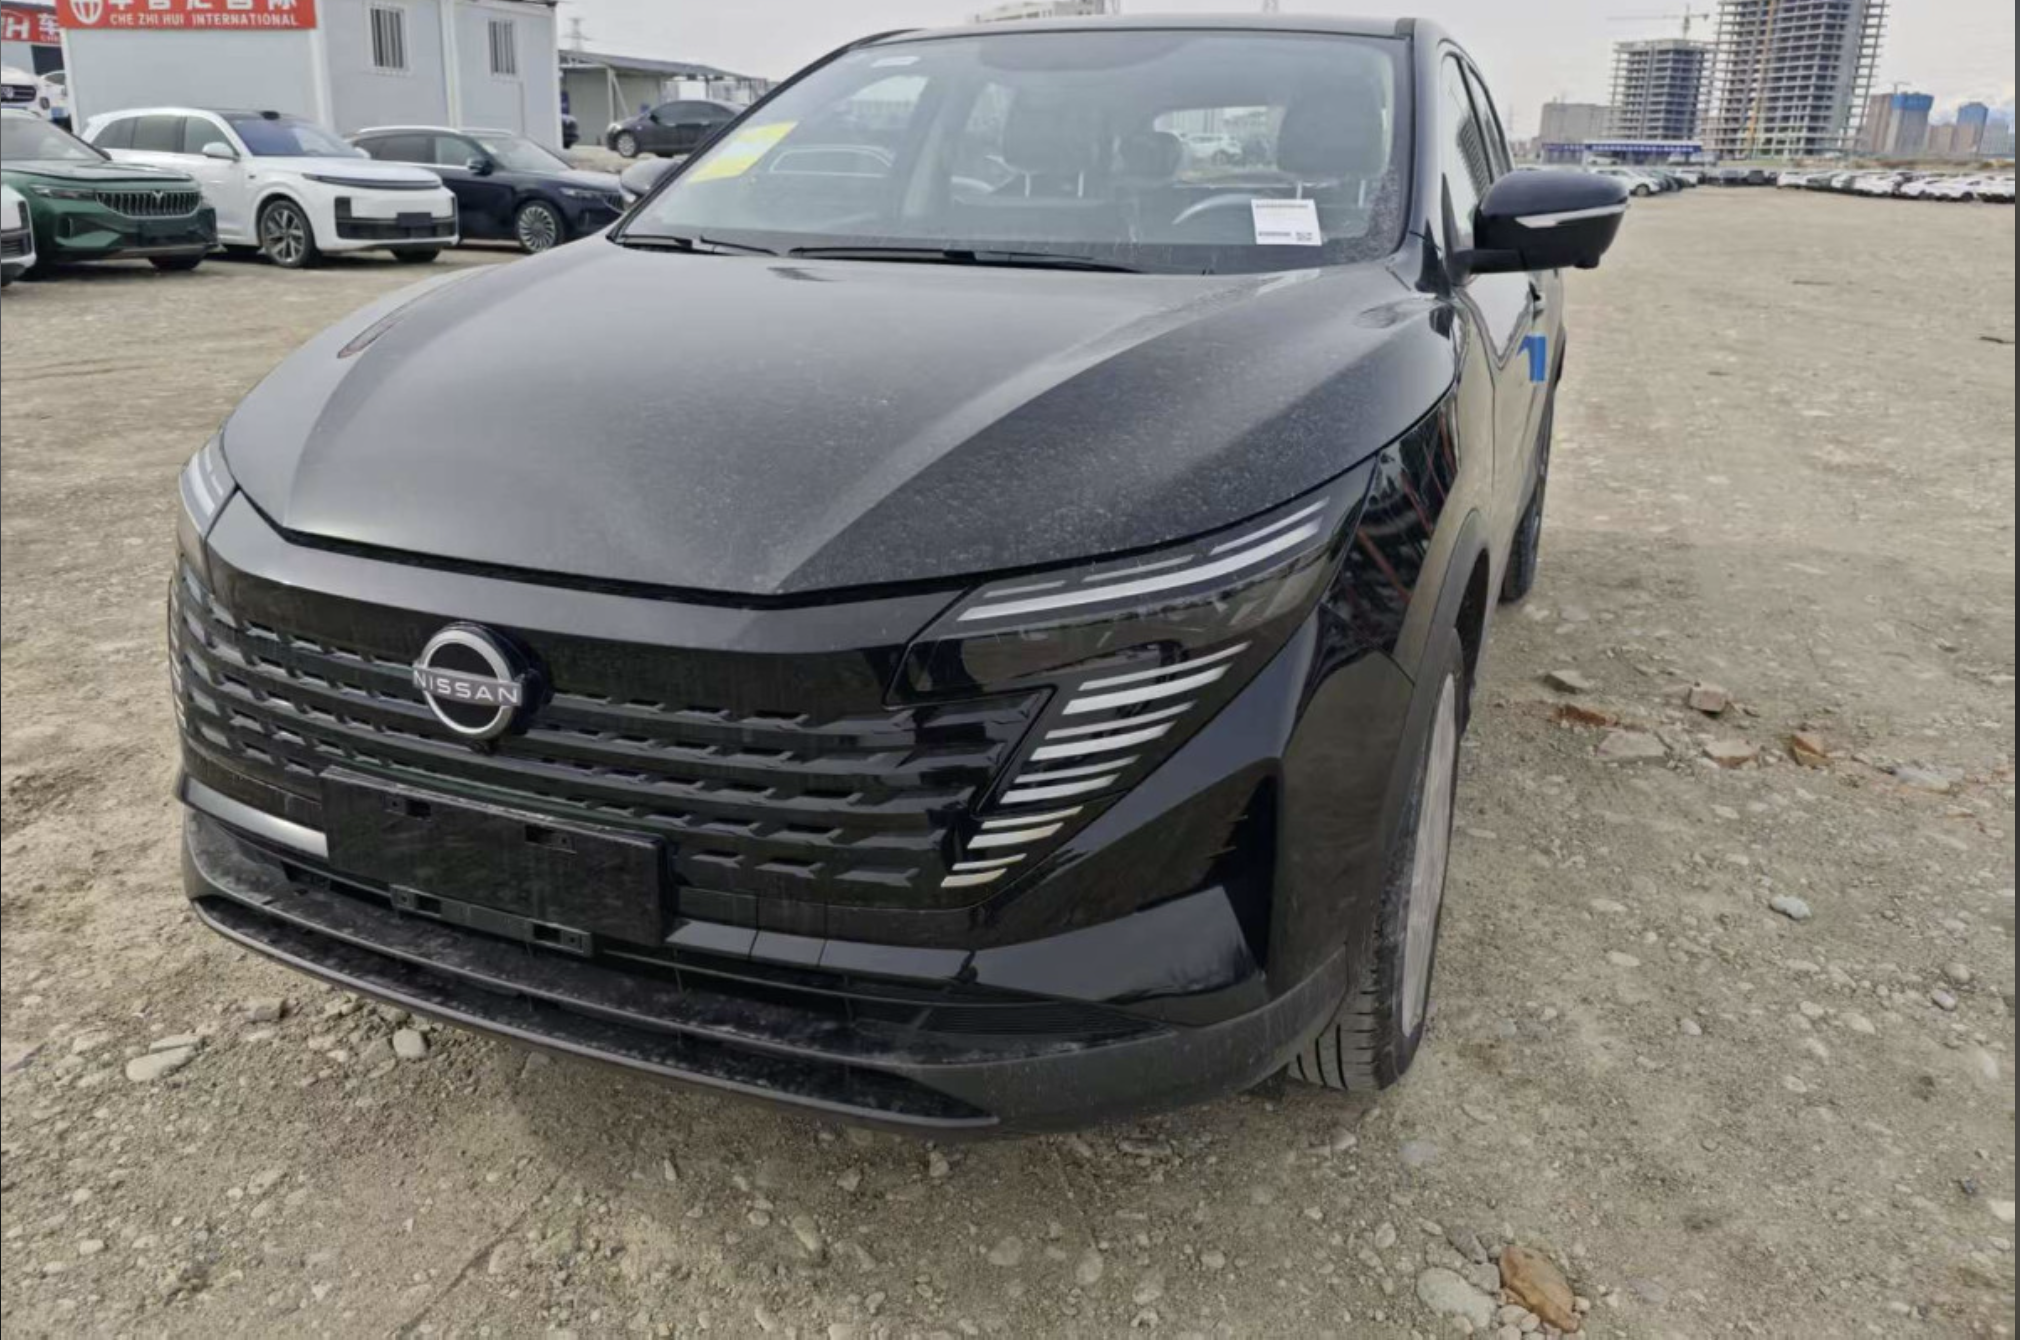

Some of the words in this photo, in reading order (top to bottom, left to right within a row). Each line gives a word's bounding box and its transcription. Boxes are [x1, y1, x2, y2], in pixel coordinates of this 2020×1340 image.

[110, 14, 134, 26] CHE
[138, 14, 159, 26] ZHI
[163, 14, 184, 26] HUI
[191, 13, 298, 26] INTERNATIONAL
[413, 668, 519, 703] NISSAN
